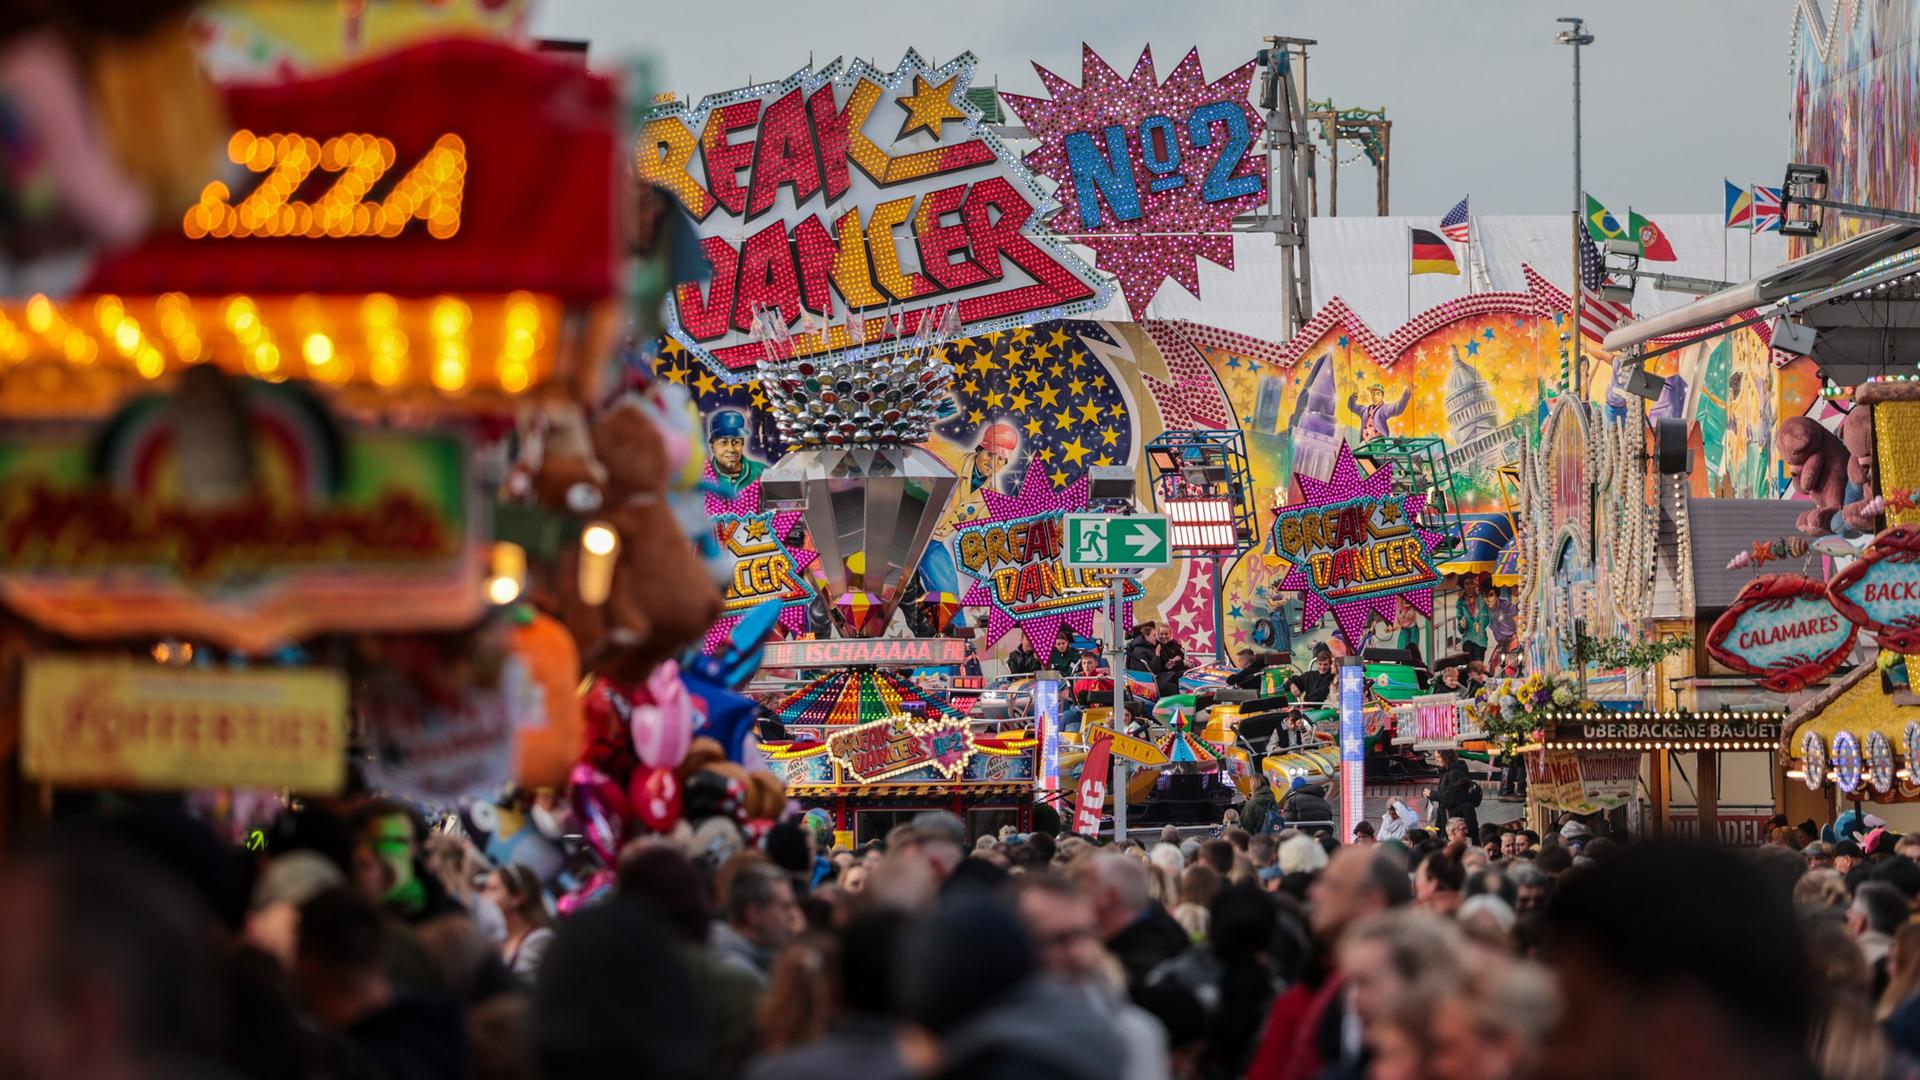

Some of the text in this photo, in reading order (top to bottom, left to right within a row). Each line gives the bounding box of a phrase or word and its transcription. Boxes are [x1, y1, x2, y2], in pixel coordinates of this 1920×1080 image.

[635, 77, 895, 221] REAK
[184, 130, 467, 239] ZZA
[1281, 502, 1382, 556] BREAK
[1308, 537, 1428, 589] DANCER
[1864, 581, 1920, 602] BACK
[1739, 614, 1838, 650] CALAMARES
[831, 722, 893, 758] BREAK
[851, 735, 928, 774] DANCER
[1551, 759, 1581, 788] Mais
